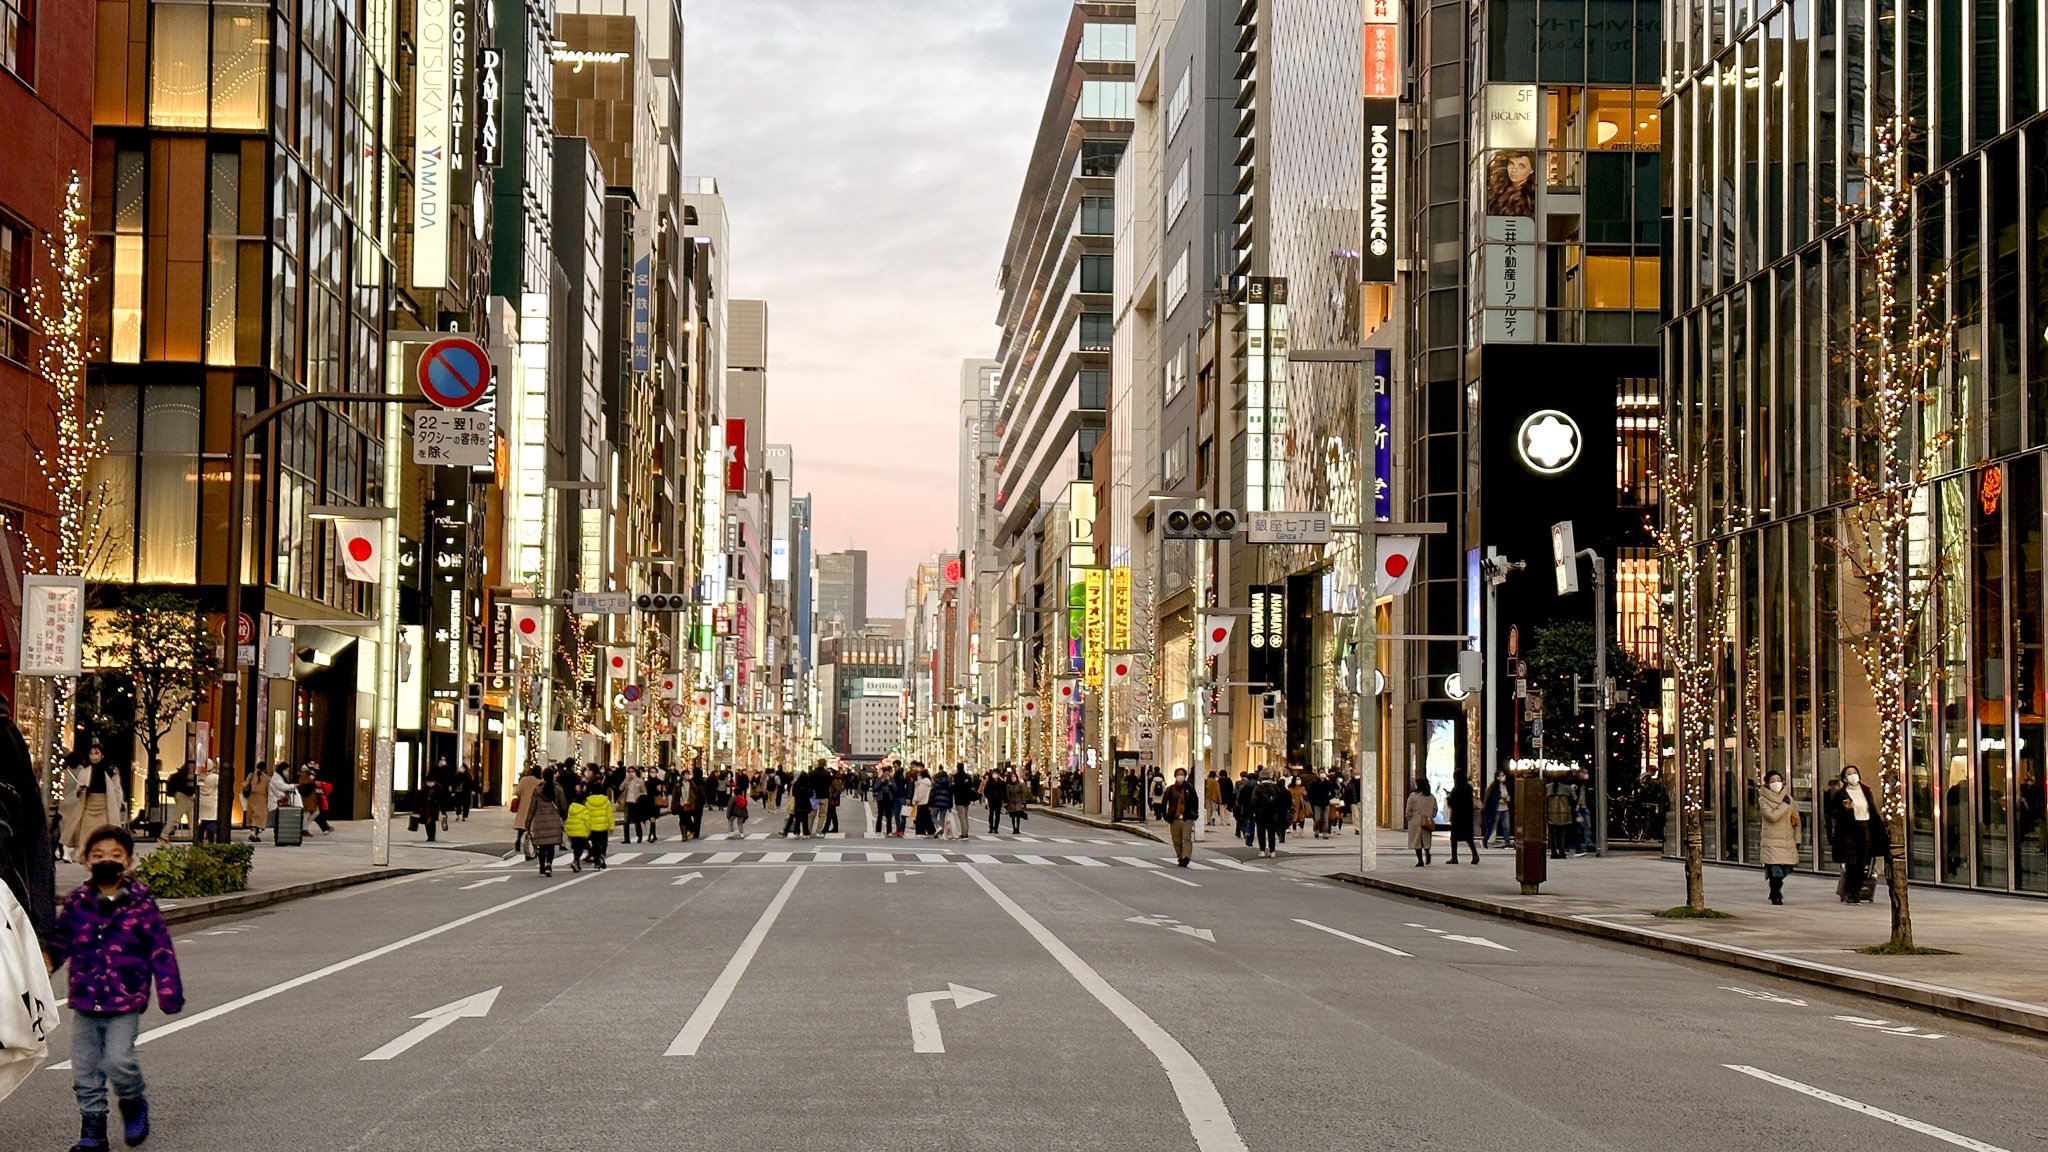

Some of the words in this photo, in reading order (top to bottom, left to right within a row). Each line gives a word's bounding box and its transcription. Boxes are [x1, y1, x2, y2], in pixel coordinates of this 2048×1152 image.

[422, 23, 444, 118] OTSUKA
[1374, 28, 1387, 94] 東京美容外科
[451, 12, 465, 170] CONSTANTIN
[483, 51, 499, 163] DAMIANI
[1490, 111, 1532, 121] BIGUINE
[1517, 89, 1533, 102] 5F
[420, 145, 442, 229] YAMADA
[1370, 125, 1388, 240] MONTBLANC
[1504, 219, 1517, 337] 三井不動産リアルティ
[635, 274, 649, 358] 名鉄観光
[418, 431, 486, 446] タクシーの客待ち
[418, 446, 450, 459] を除く
[1255, 519, 1326, 532] 銀座七丁目
[1275, 532, 1296, 540] Ginza
[1299, 532, 1304, 540] 7
[450, 589, 461, 640] CONSTANTIN
[1251, 592, 1265, 635] YAMAHA
[449, 640, 460, 684] VACHERON
